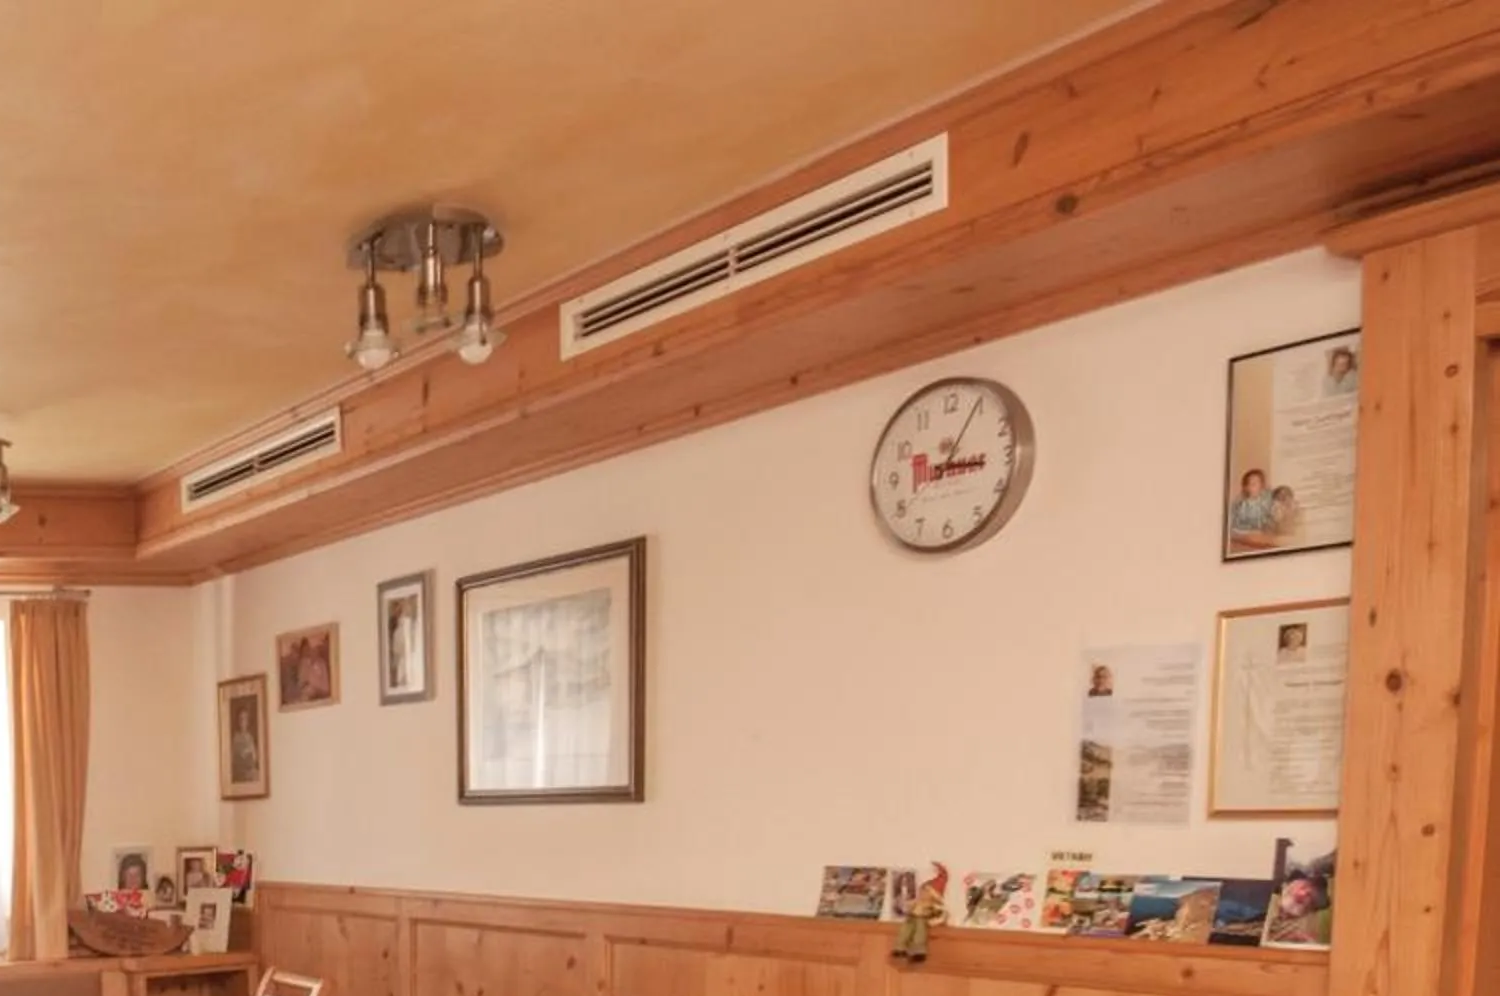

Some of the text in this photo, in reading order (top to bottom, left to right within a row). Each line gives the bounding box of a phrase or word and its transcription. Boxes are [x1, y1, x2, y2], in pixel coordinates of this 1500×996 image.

[943, 392, 960, 415] 12
[916, 409, 931, 432] 11
[997, 416, 1012, 438] 2
[897, 440, 913, 462] 10
[1003, 444, 1014, 466] 3
[888, 470, 900, 490] 9
[915, 516, 927, 538] 7
[942, 518, 954, 540] 6
